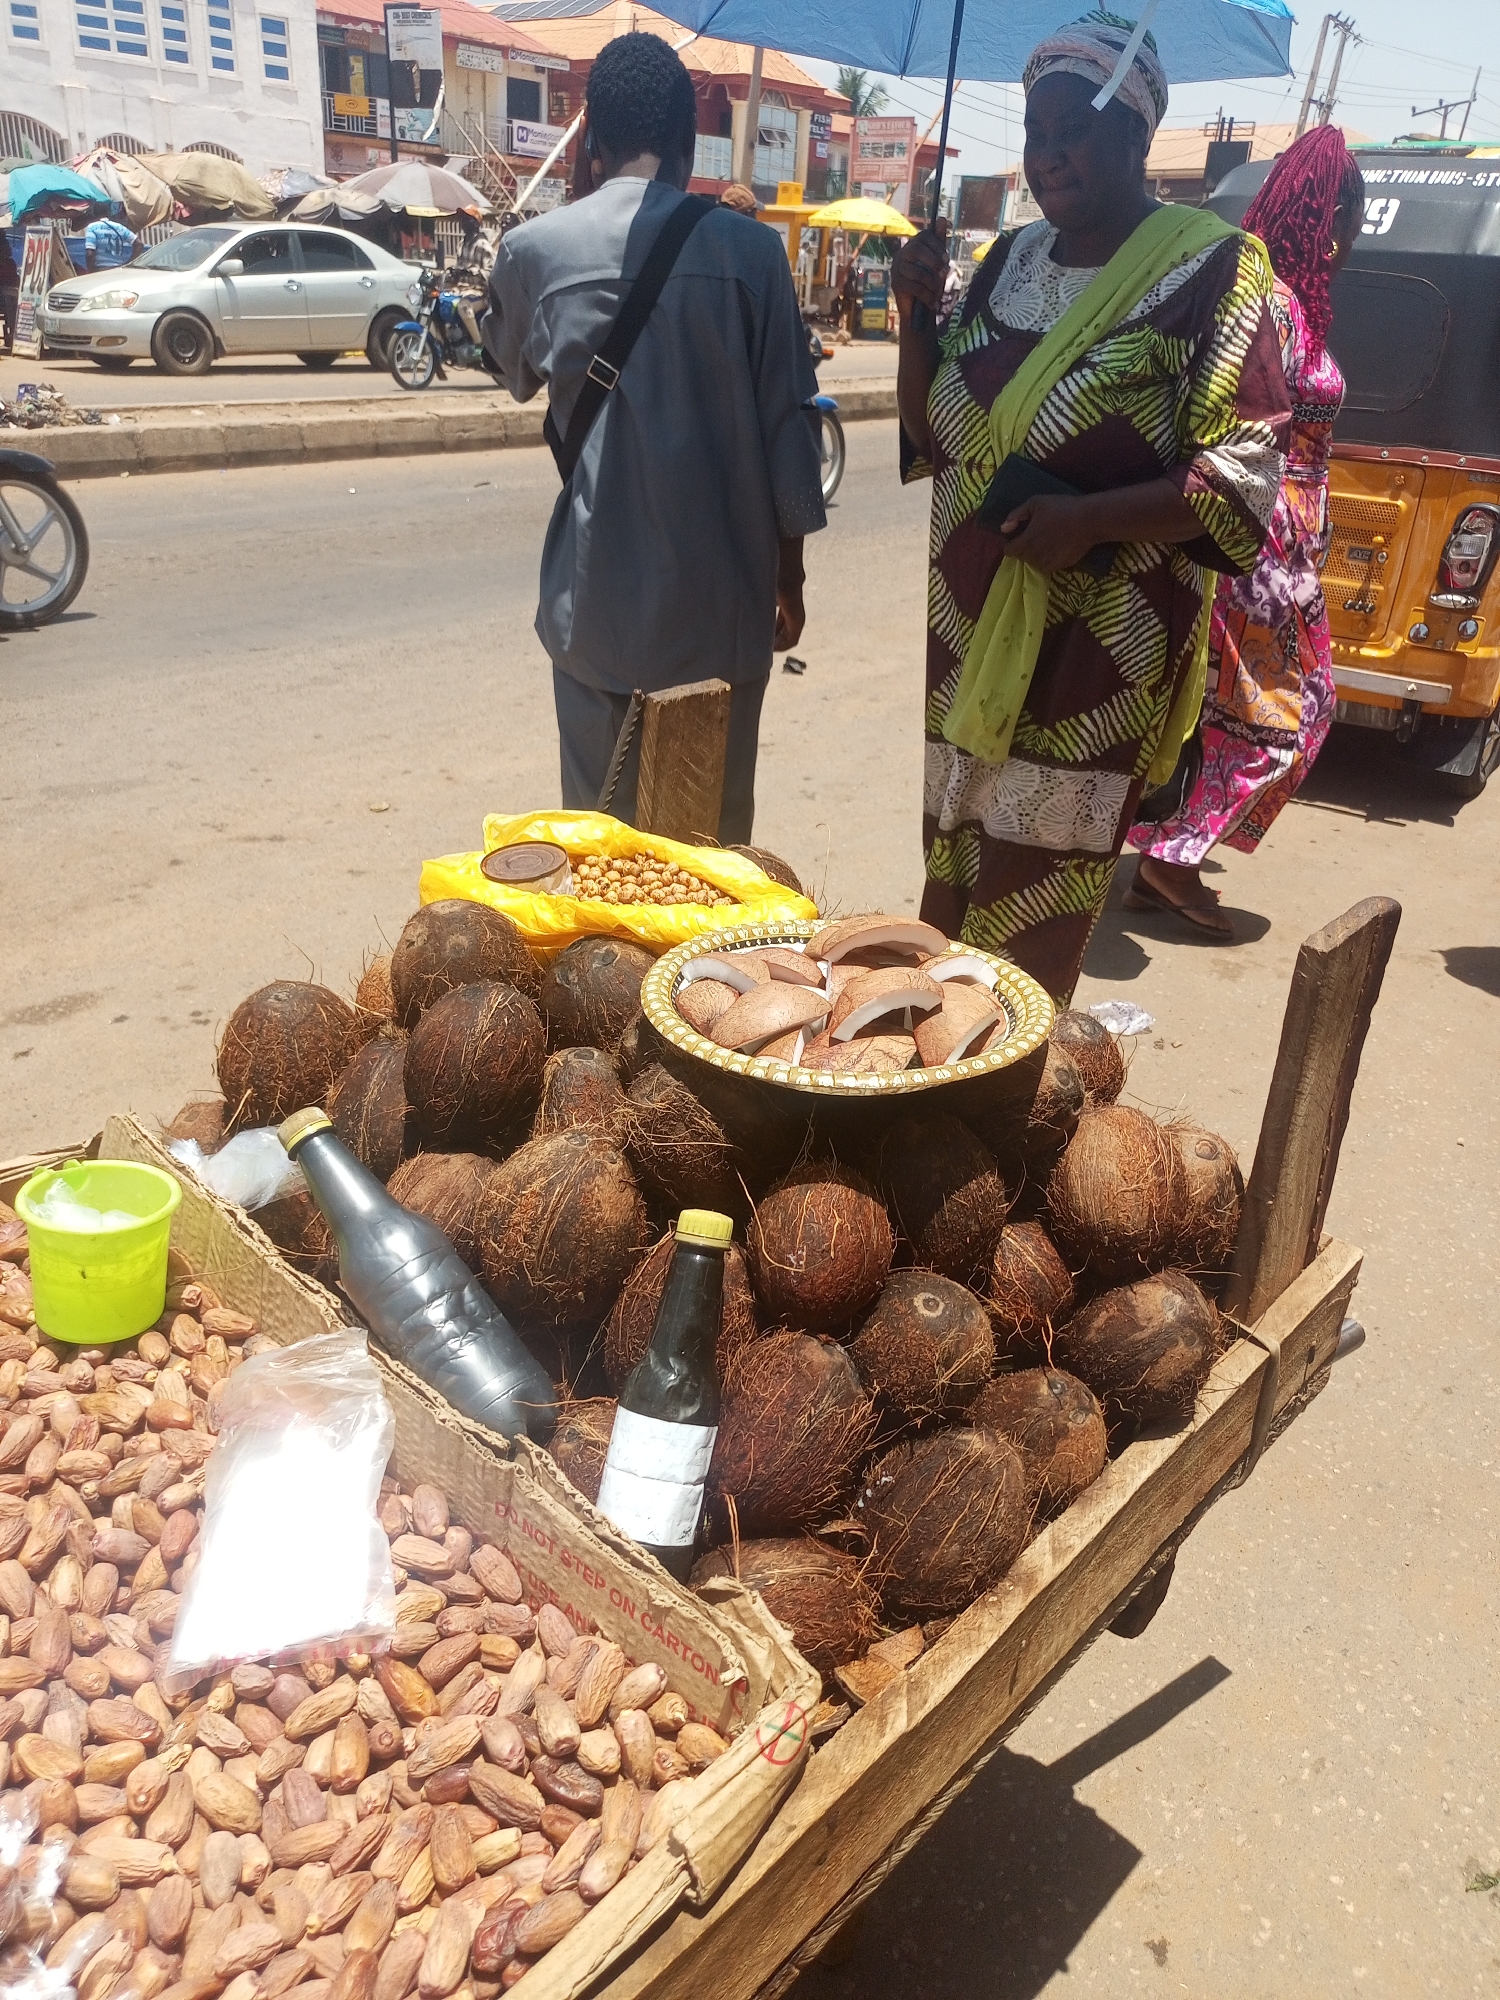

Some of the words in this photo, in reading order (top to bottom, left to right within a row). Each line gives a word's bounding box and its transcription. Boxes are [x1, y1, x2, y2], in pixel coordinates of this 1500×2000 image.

[814, 113, 831, 125] FISH
[528, 128, 563, 142] Moniepoin
[1361, 169, 1429, 184] UNCTION
[21, 237, 50, 295] POS
[495, 1501, 519, 1525] DO
[522, 1518, 557, 1555] NOT
[560, 1549, 606, 1590] STEP
[610, 1588, 636, 1620] ON
[640, 1612, 720, 1687] CARTON
[528, 1571, 560, 1604] USE
